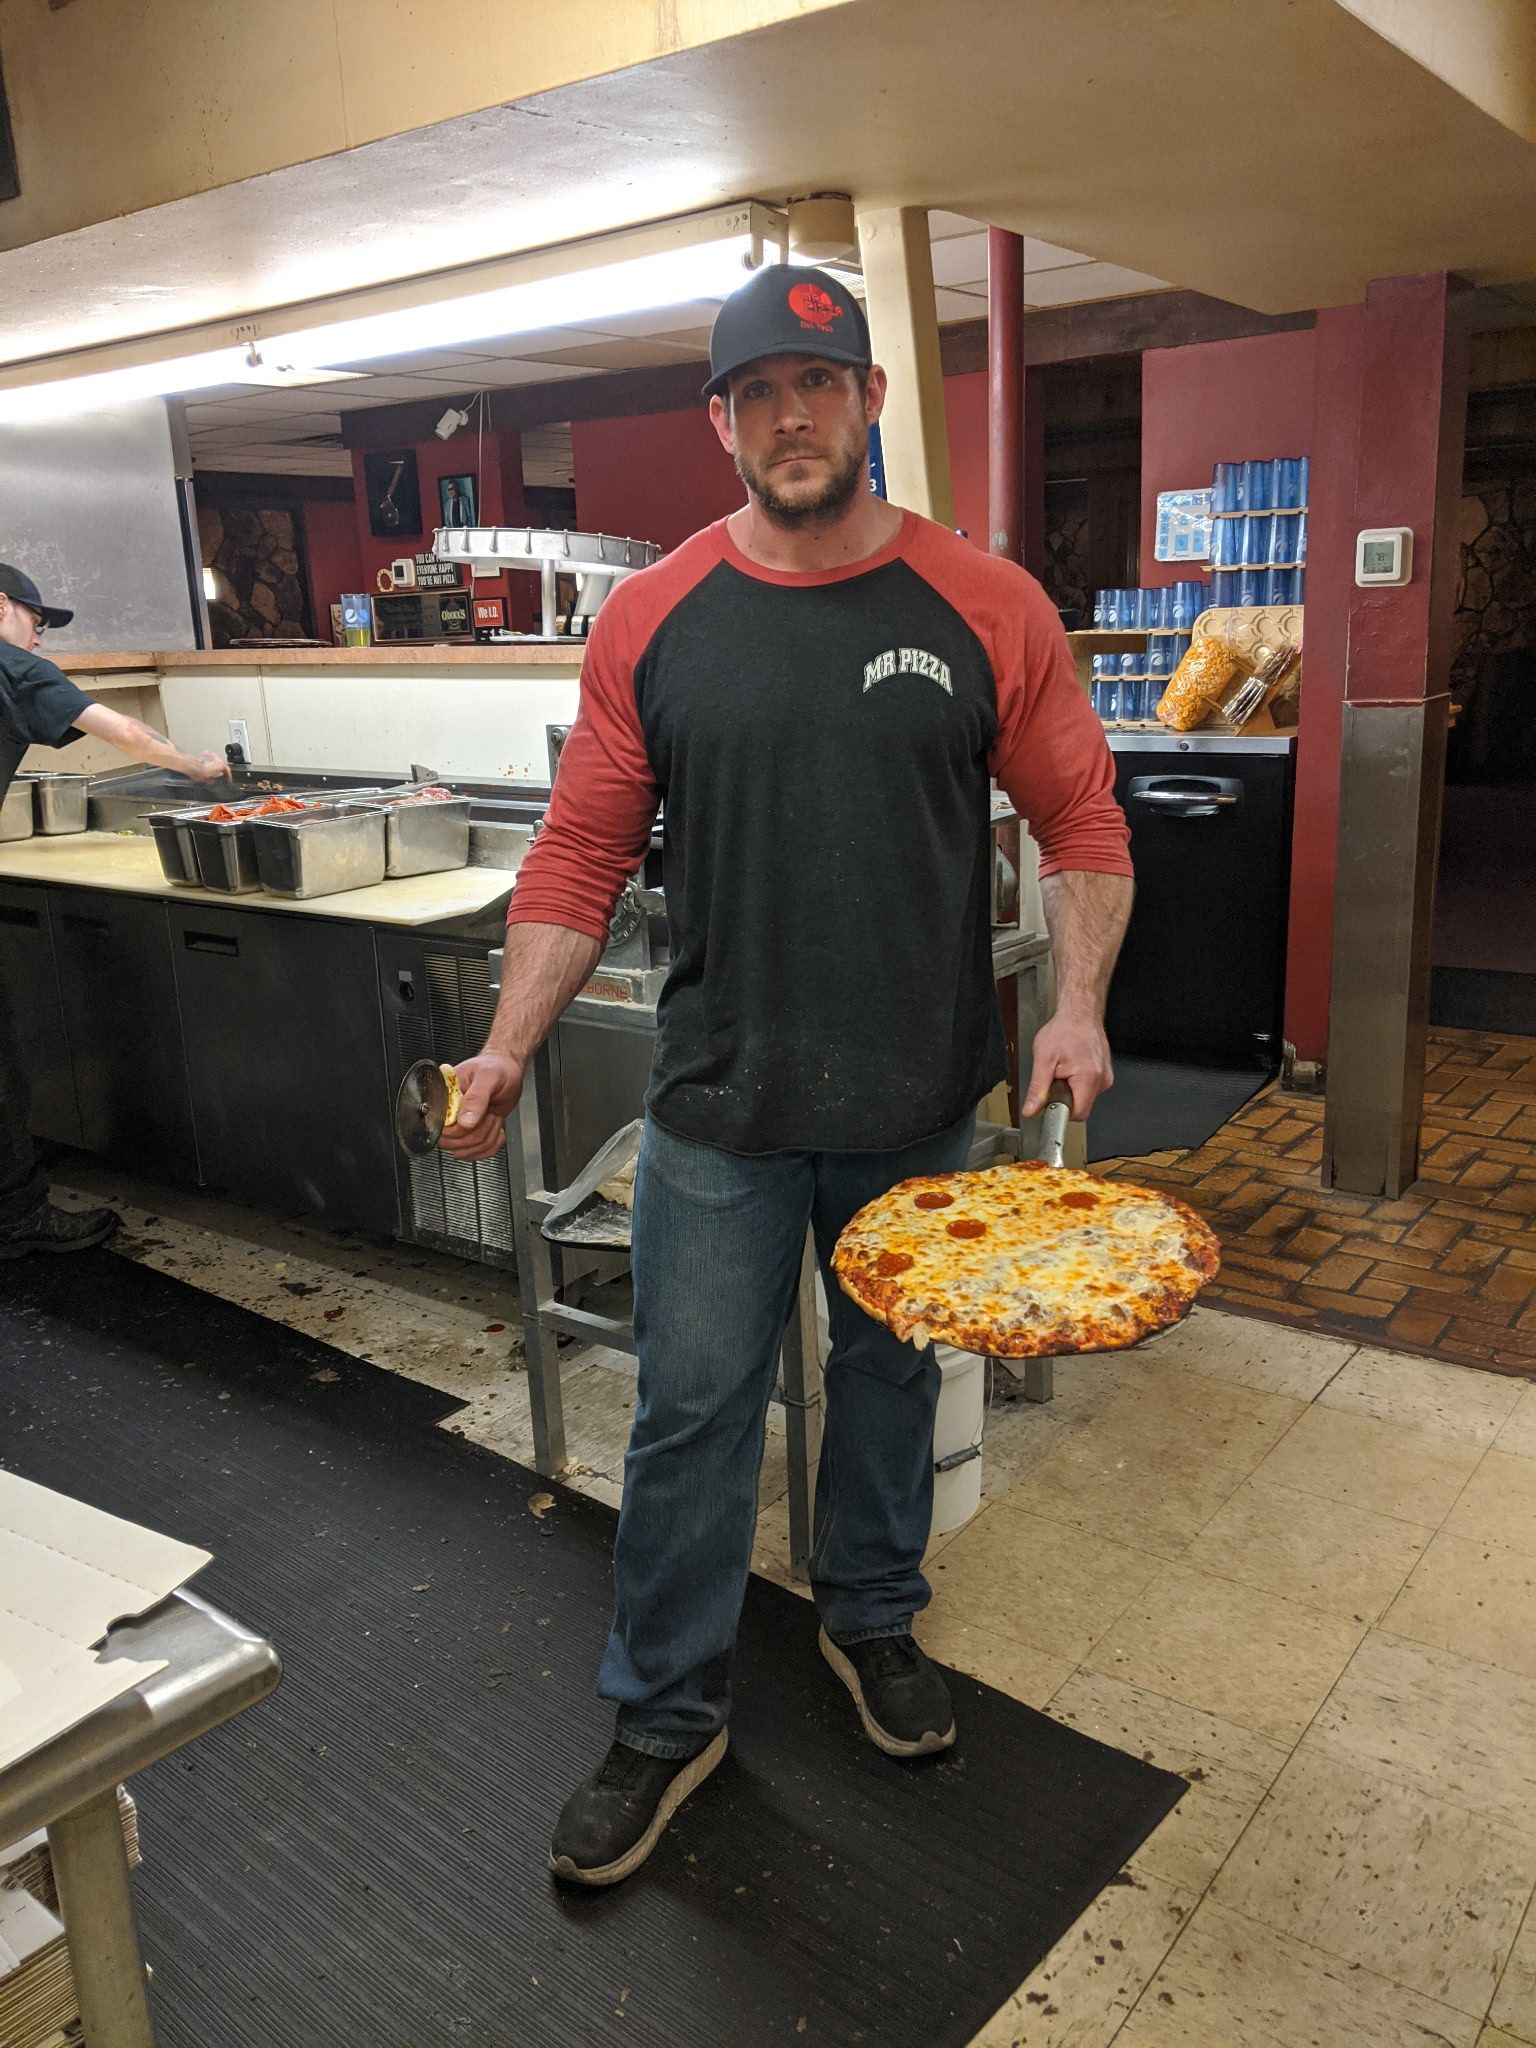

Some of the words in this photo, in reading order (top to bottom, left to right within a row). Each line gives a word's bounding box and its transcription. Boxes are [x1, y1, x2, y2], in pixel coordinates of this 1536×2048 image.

[415, 553, 424, 564] YOU
[416, 563, 438, 575] EVERYONE
[438, 562, 454, 574] HAPPY
[433, 574, 442, 585] NOT
[442, 573, 455, 584] PIZZA
[477, 606, 488, 619] We
[488, 606, 499, 618] I.D.
[862, 649, 897, 693] MR
[898, 647, 953, 697] PIZZA
